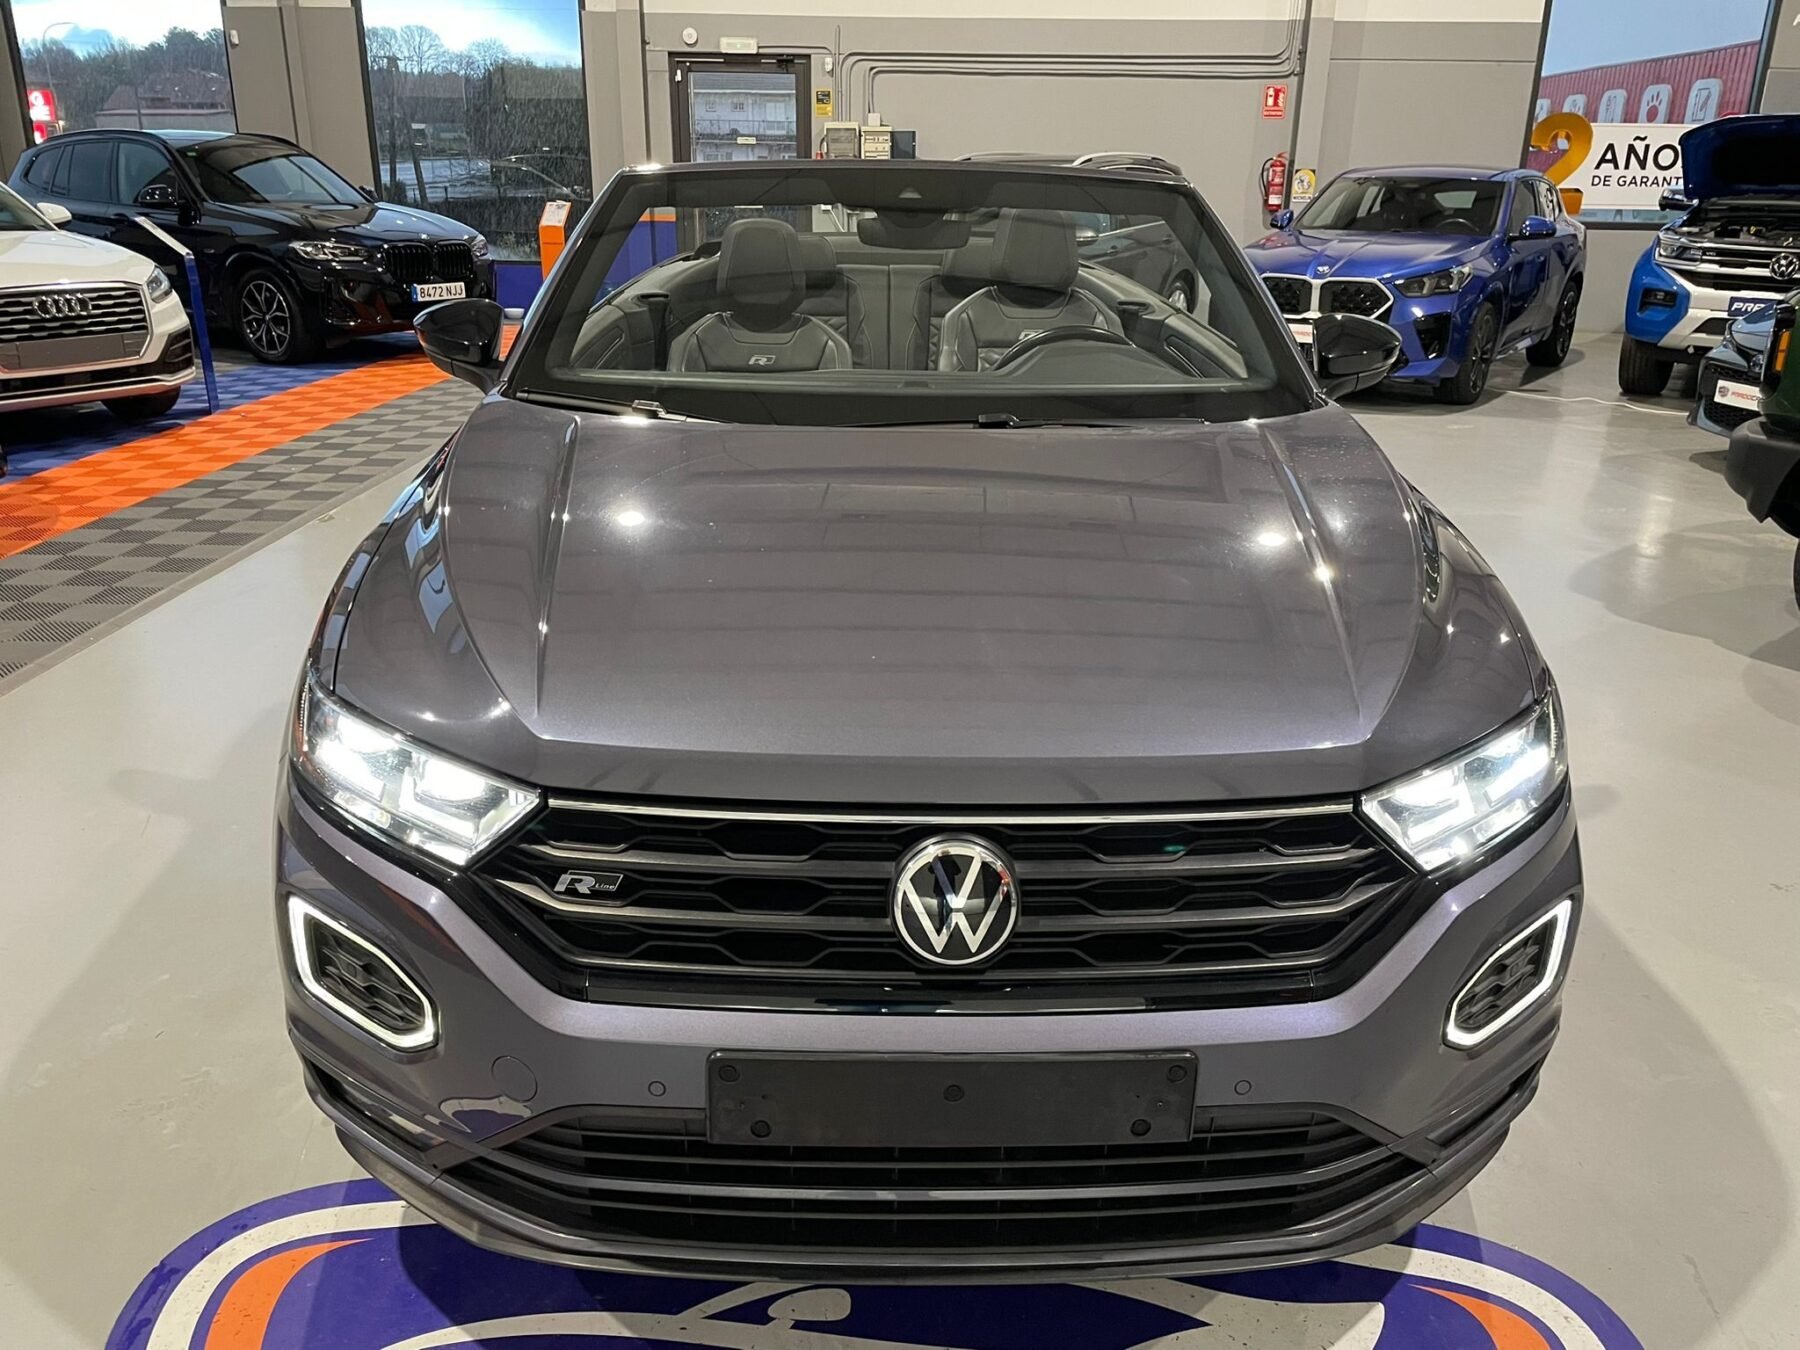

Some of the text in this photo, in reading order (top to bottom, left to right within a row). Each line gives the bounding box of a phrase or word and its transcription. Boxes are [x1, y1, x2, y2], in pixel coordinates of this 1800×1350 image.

[1594, 136, 1683, 171] AÑO
[1591, 175, 1612, 187] DE
[420, 284, 463, 298] 8472 NJJ
[553, 874, 595, 894] R
